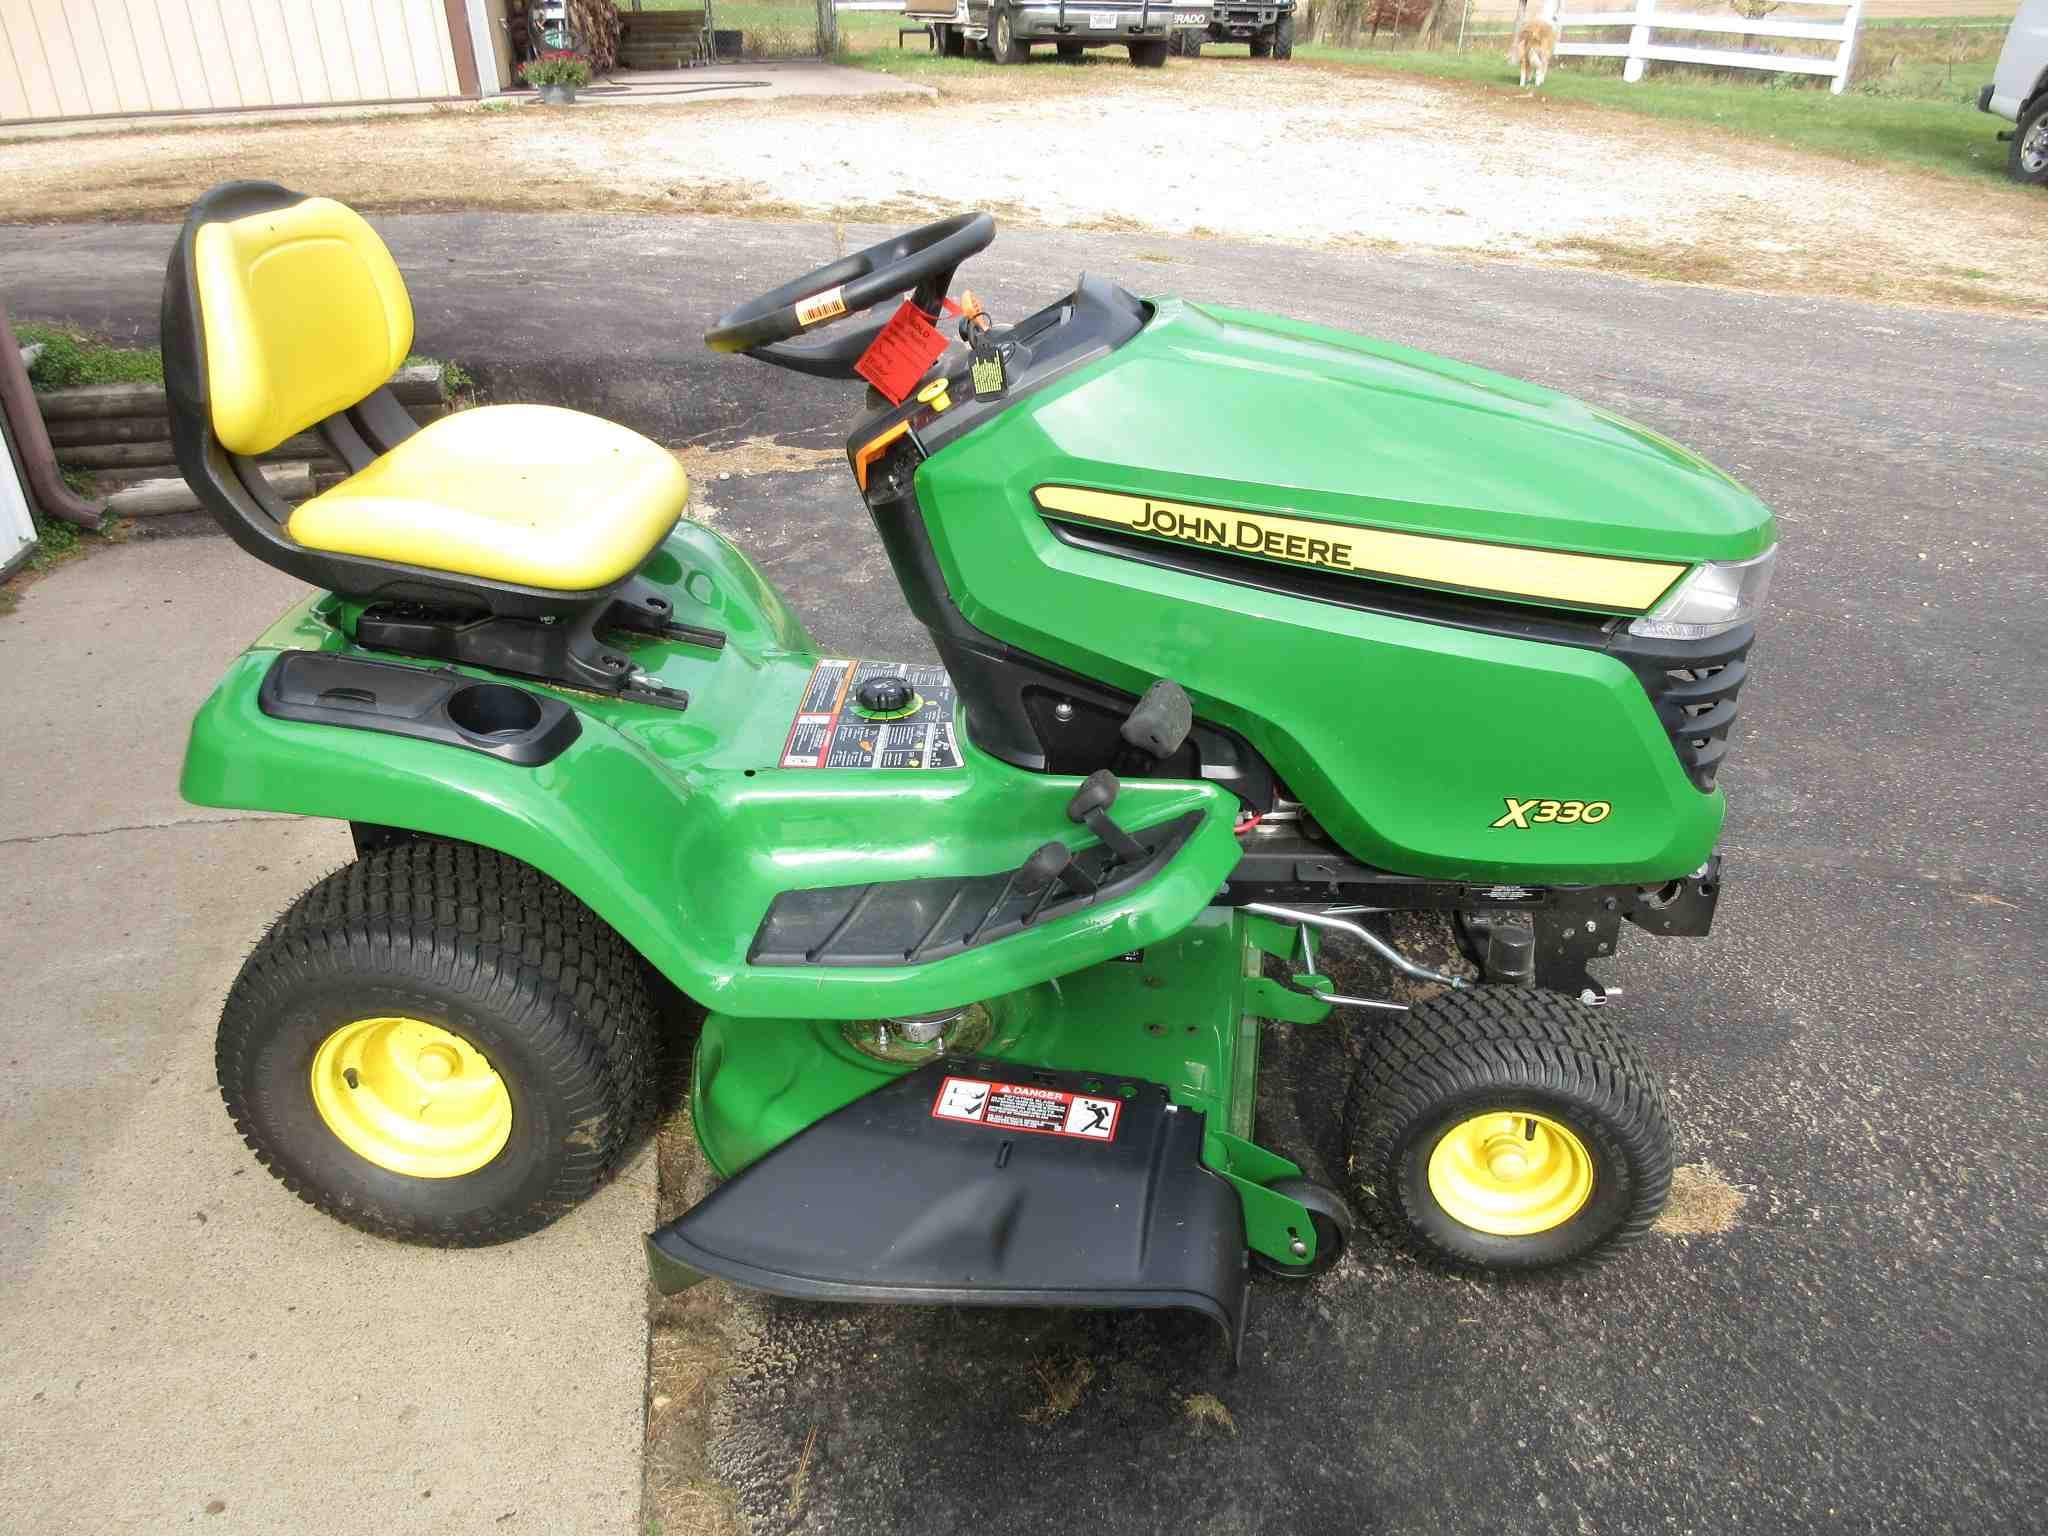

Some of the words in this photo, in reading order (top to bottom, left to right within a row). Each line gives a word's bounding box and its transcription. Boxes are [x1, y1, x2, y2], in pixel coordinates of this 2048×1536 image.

[1132, 502, 1227, 543] JOHN
[1236, 521, 1352, 566] DEERE
[1488, 797, 1612, 829] X330
[1013, 1086, 1064, 1101] DANGER
